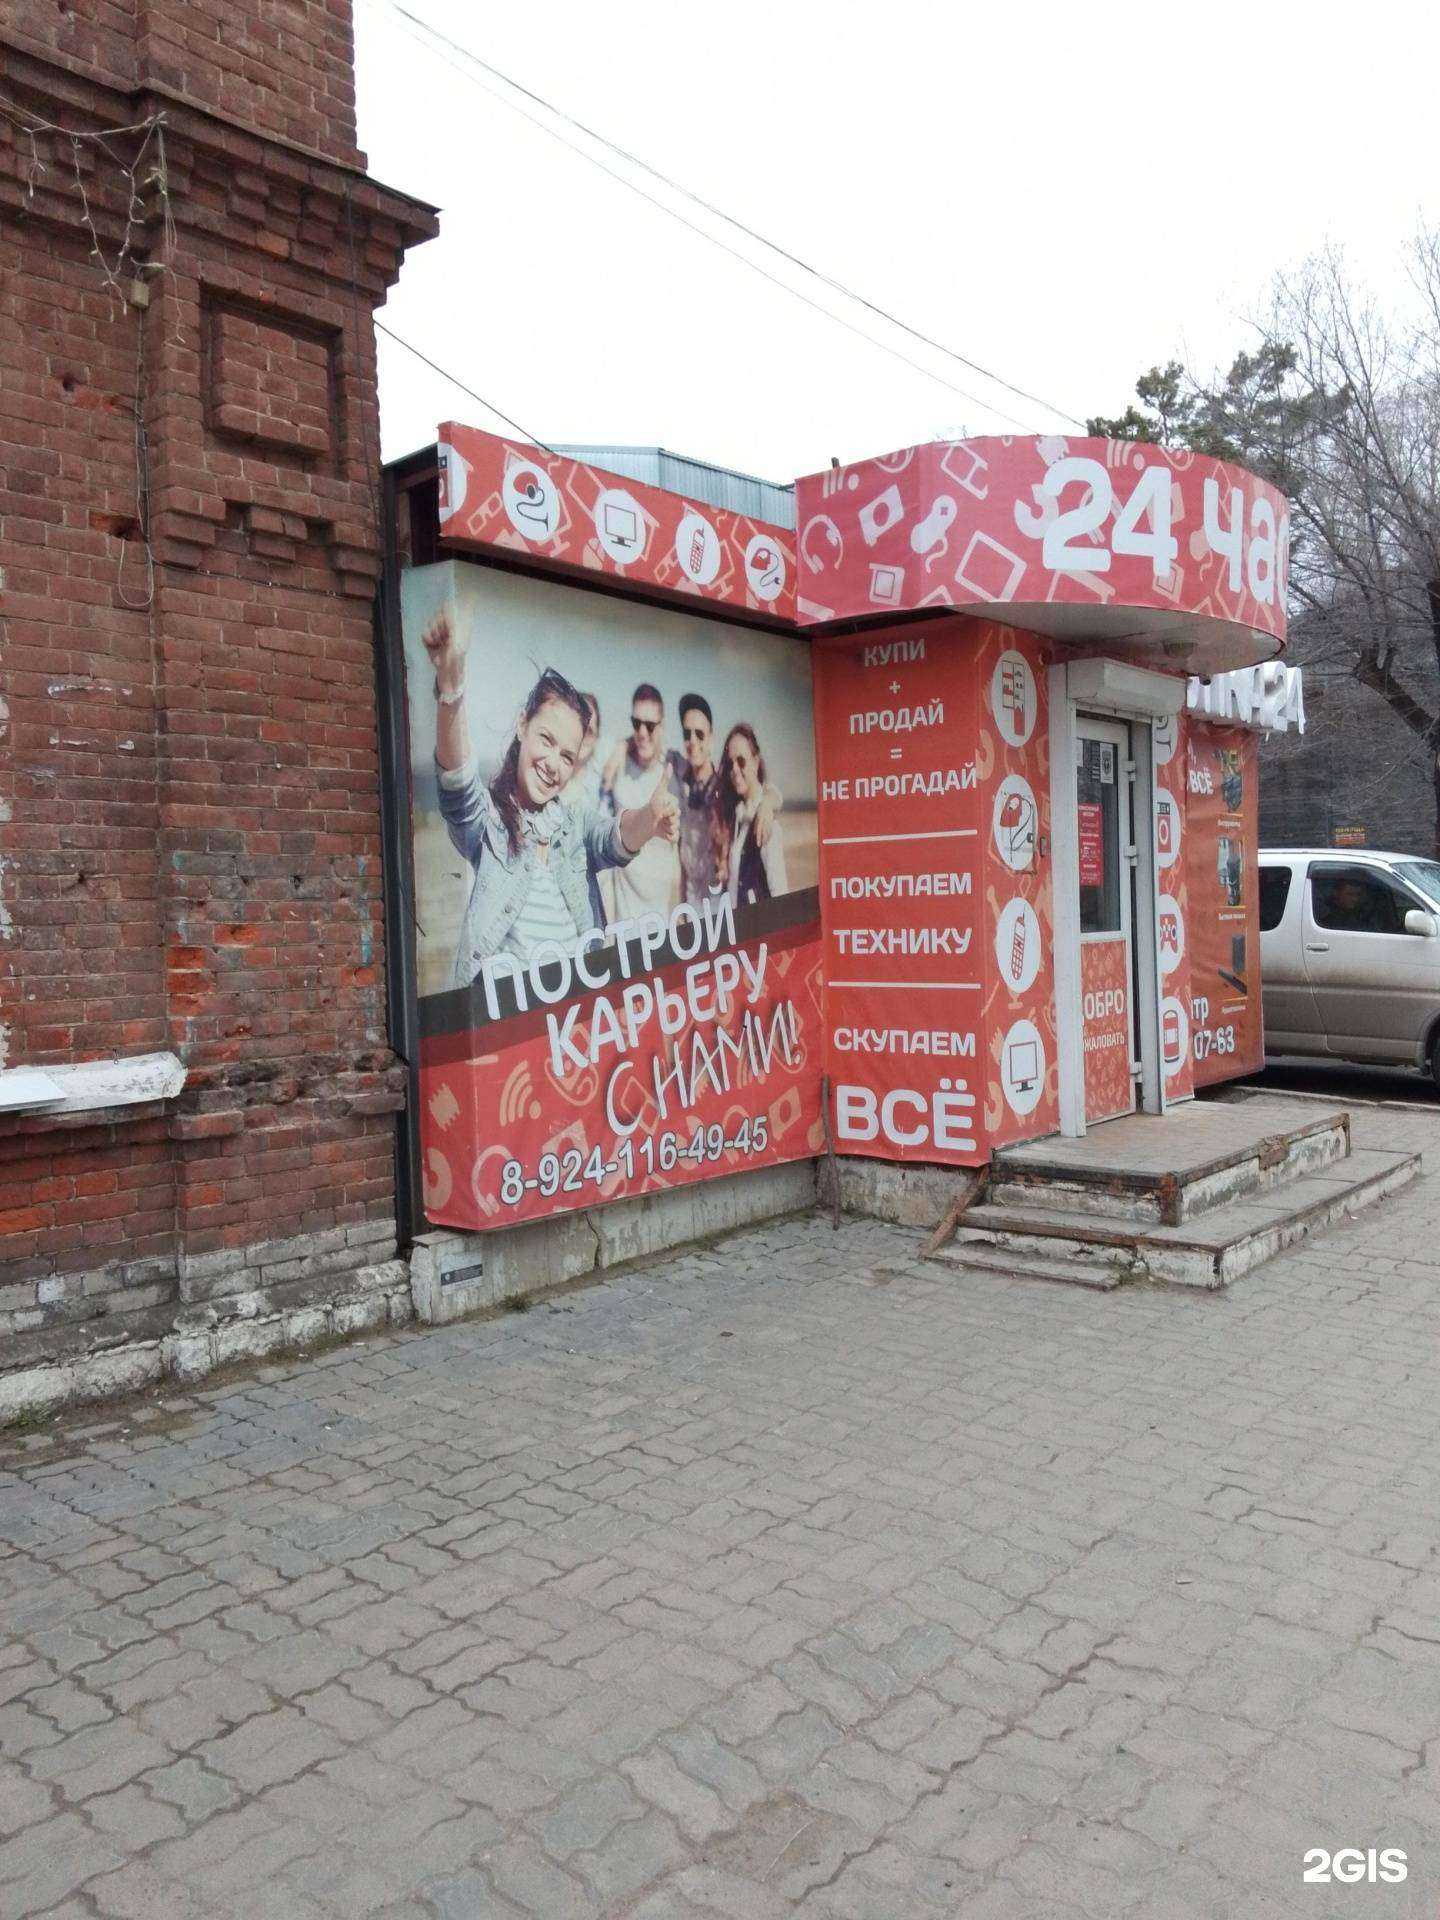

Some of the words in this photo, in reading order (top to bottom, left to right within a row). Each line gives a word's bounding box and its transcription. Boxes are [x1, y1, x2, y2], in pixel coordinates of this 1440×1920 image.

[1043, 457, 1178, 578] 24
[864, 638, 925, 667] КУПИ
[850, 698, 944, 735] ПРОДАЙ
[822, 779, 849, 800] НЕ
[855, 761, 977, 799] ПРОГАДАЙ
[831, 872, 972, 899] ПОКУПАЕМ
[481, 882, 737, 1020] ПОСТРОЙ
[833, 927, 972, 955] ТЕХНИКУ
[546, 942, 768, 1078] КАРЬЕРУ
[1083, 988, 1125, 1021] ОБРО
[833, 1028, 976, 1057] СКУПАЕМ
[1083, 1031, 1125, 1053] ЖАЛОВАТЬ
[606, 1061, 642, 1136] С
[653, 1000, 802, 1120] НАМИ!
[836, 1078, 977, 1151] ВСЁ
[500, 1116, 768, 1206] 8-924-116-49-45
